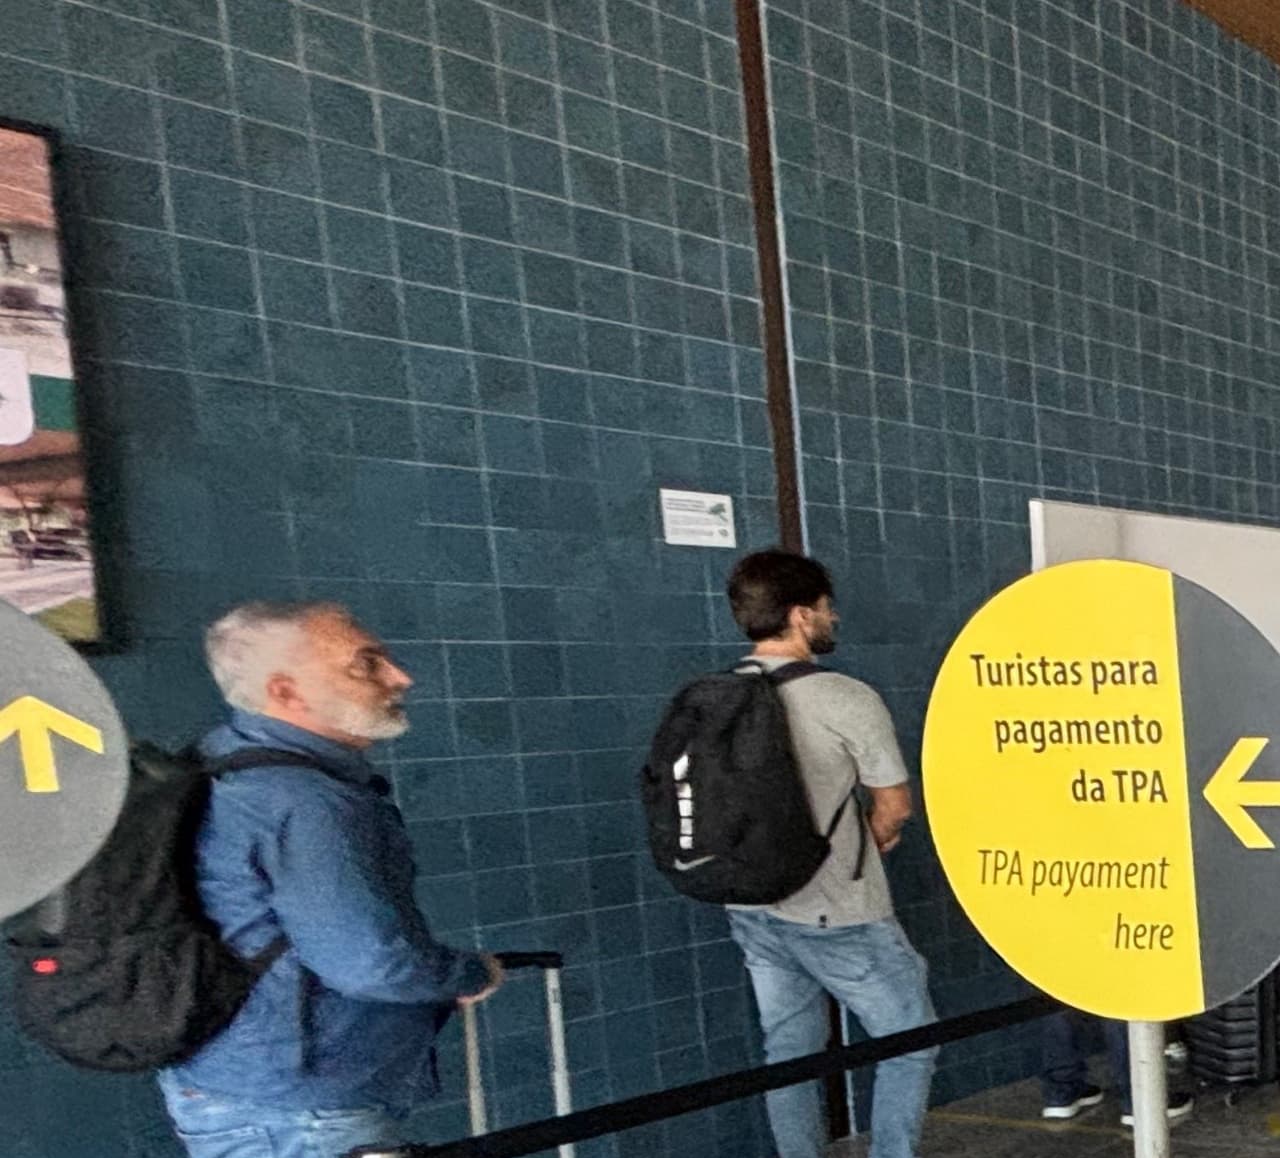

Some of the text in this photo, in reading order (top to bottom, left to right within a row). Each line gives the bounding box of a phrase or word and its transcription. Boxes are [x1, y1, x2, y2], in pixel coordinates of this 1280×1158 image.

[969, 652, 1160, 696] Turistas para
[994, 713, 1163, 754] pagamento
[1071, 768, 1169, 804] da TPA
[977, 849, 1171, 898] TPA payament
[1114, 912, 1174, 951] here
